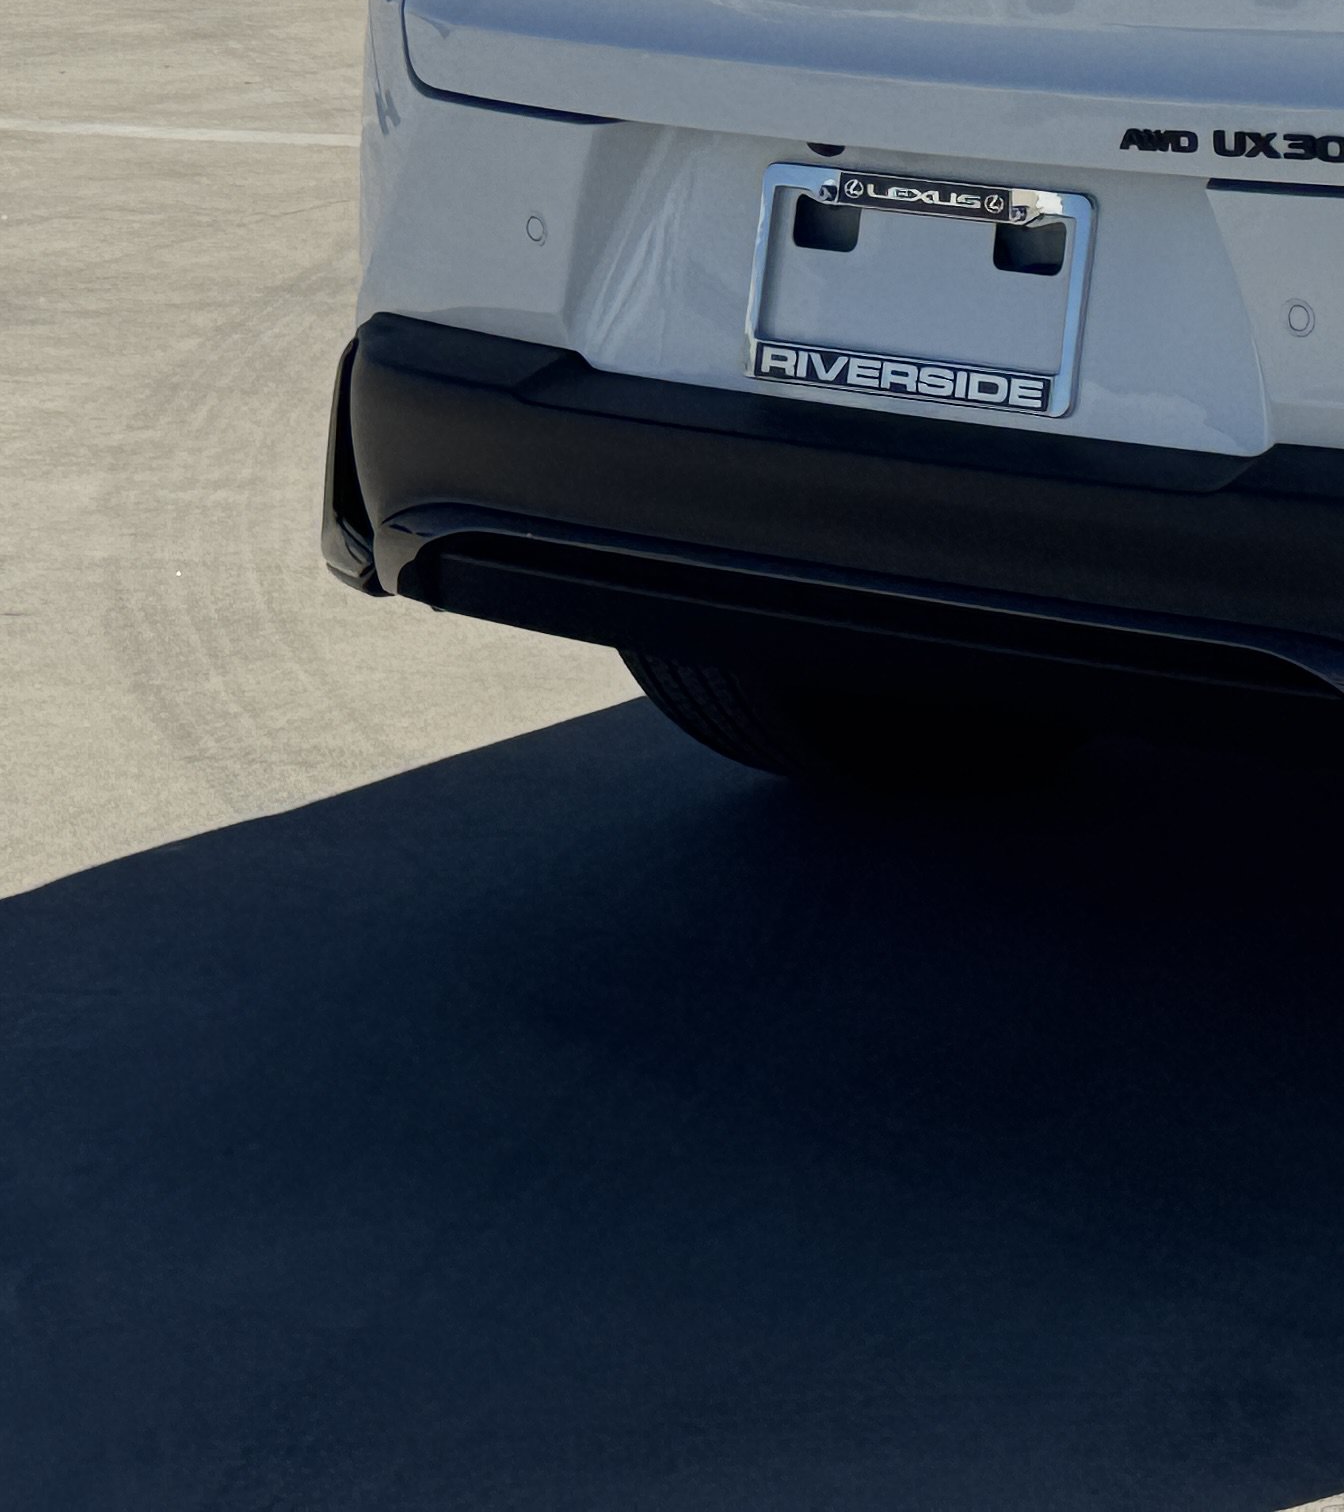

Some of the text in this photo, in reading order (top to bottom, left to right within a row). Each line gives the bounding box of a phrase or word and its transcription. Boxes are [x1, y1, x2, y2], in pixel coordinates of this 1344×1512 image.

[1119, 127, 1199, 154] AWD
[866, 183, 982, 209] LEXUS
[760, 344, 1044, 408] RIVERSIDE
